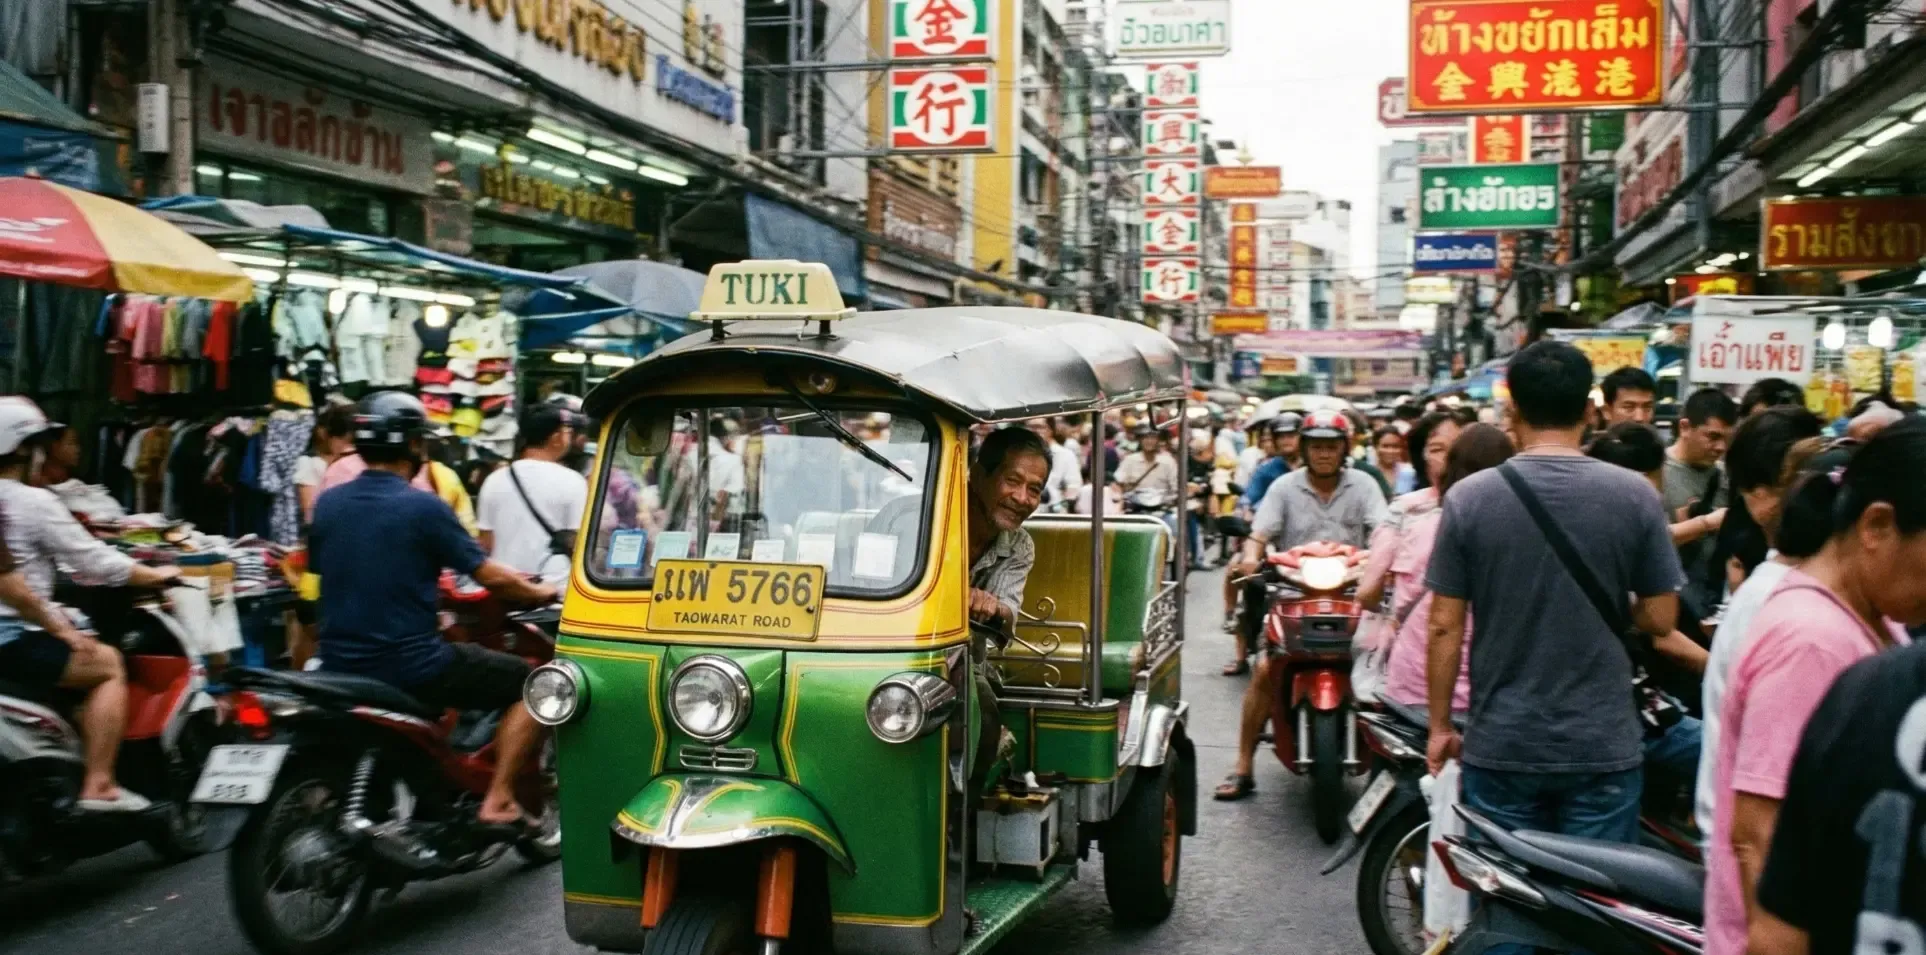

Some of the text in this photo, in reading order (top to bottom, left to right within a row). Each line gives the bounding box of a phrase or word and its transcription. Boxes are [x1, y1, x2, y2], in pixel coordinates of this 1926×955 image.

[914, 0, 967, 136] 金行
[721, 273, 809, 305] TUKI
[727, 569, 813, 606] 5766
[674, 611, 791, 628] TAOWARAT ROAD
